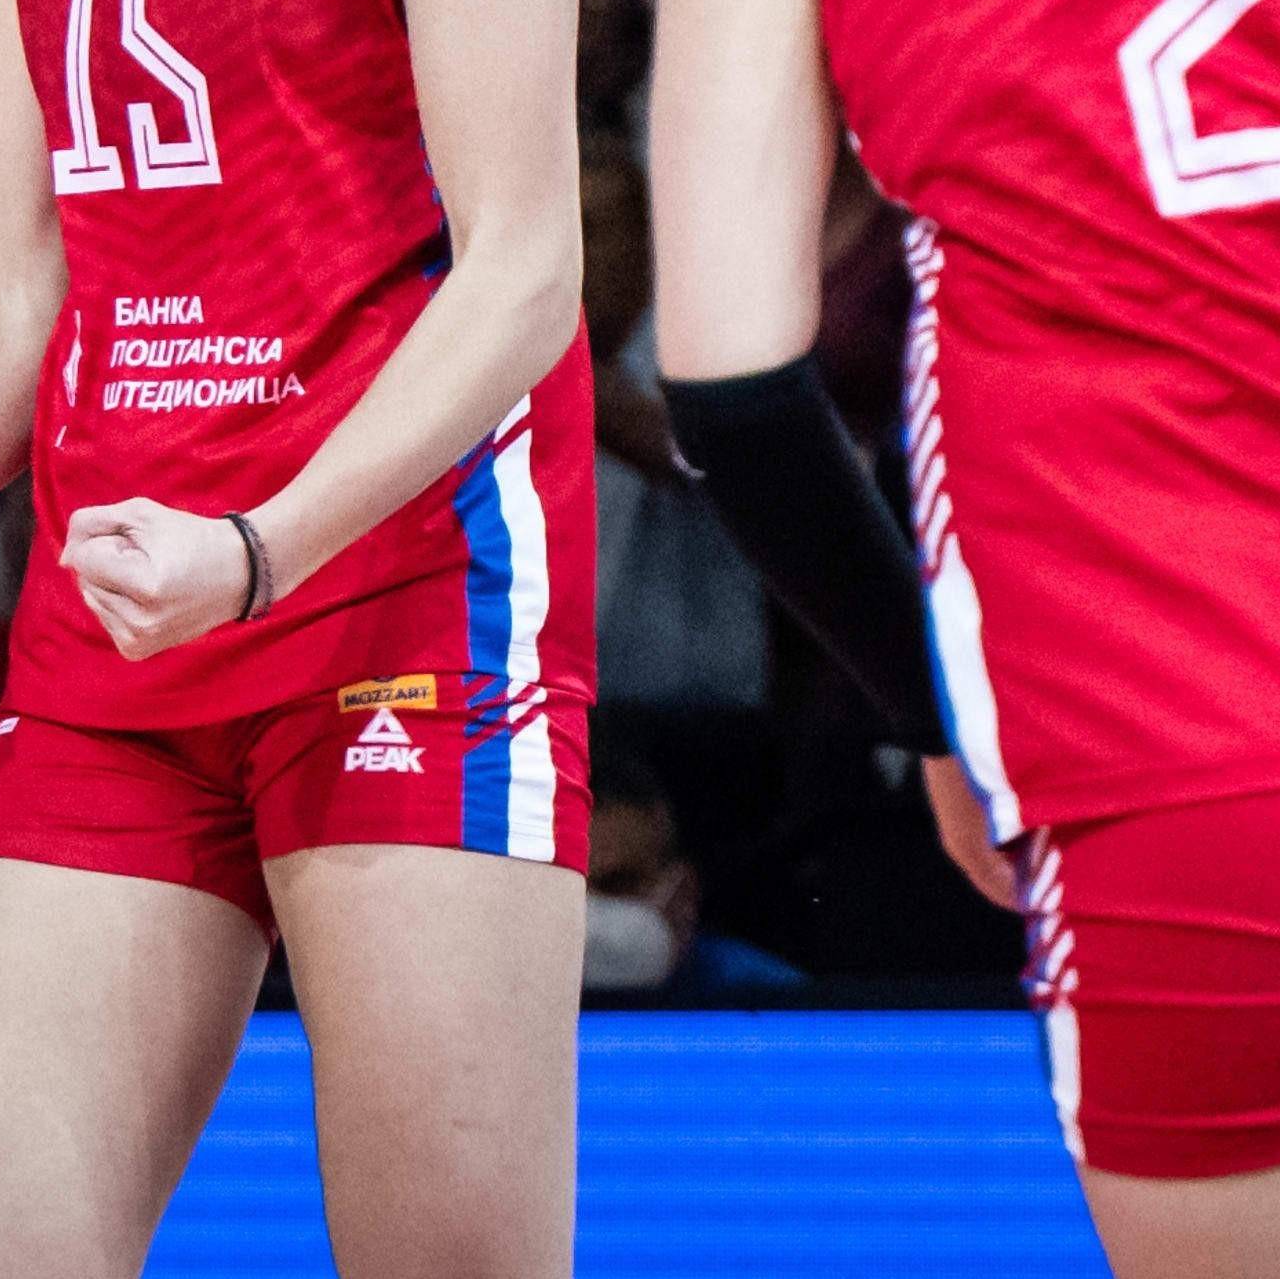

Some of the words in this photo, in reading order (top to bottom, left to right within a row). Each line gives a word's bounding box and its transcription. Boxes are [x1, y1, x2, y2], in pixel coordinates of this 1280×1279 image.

[114, 295, 204, 328] БАНКА
[110, 335, 283, 368] ПОШТАНСКА
[103, 371, 306, 413] ШТЕДИОНИЦА
[344, 745, 427, 774] PEAK
